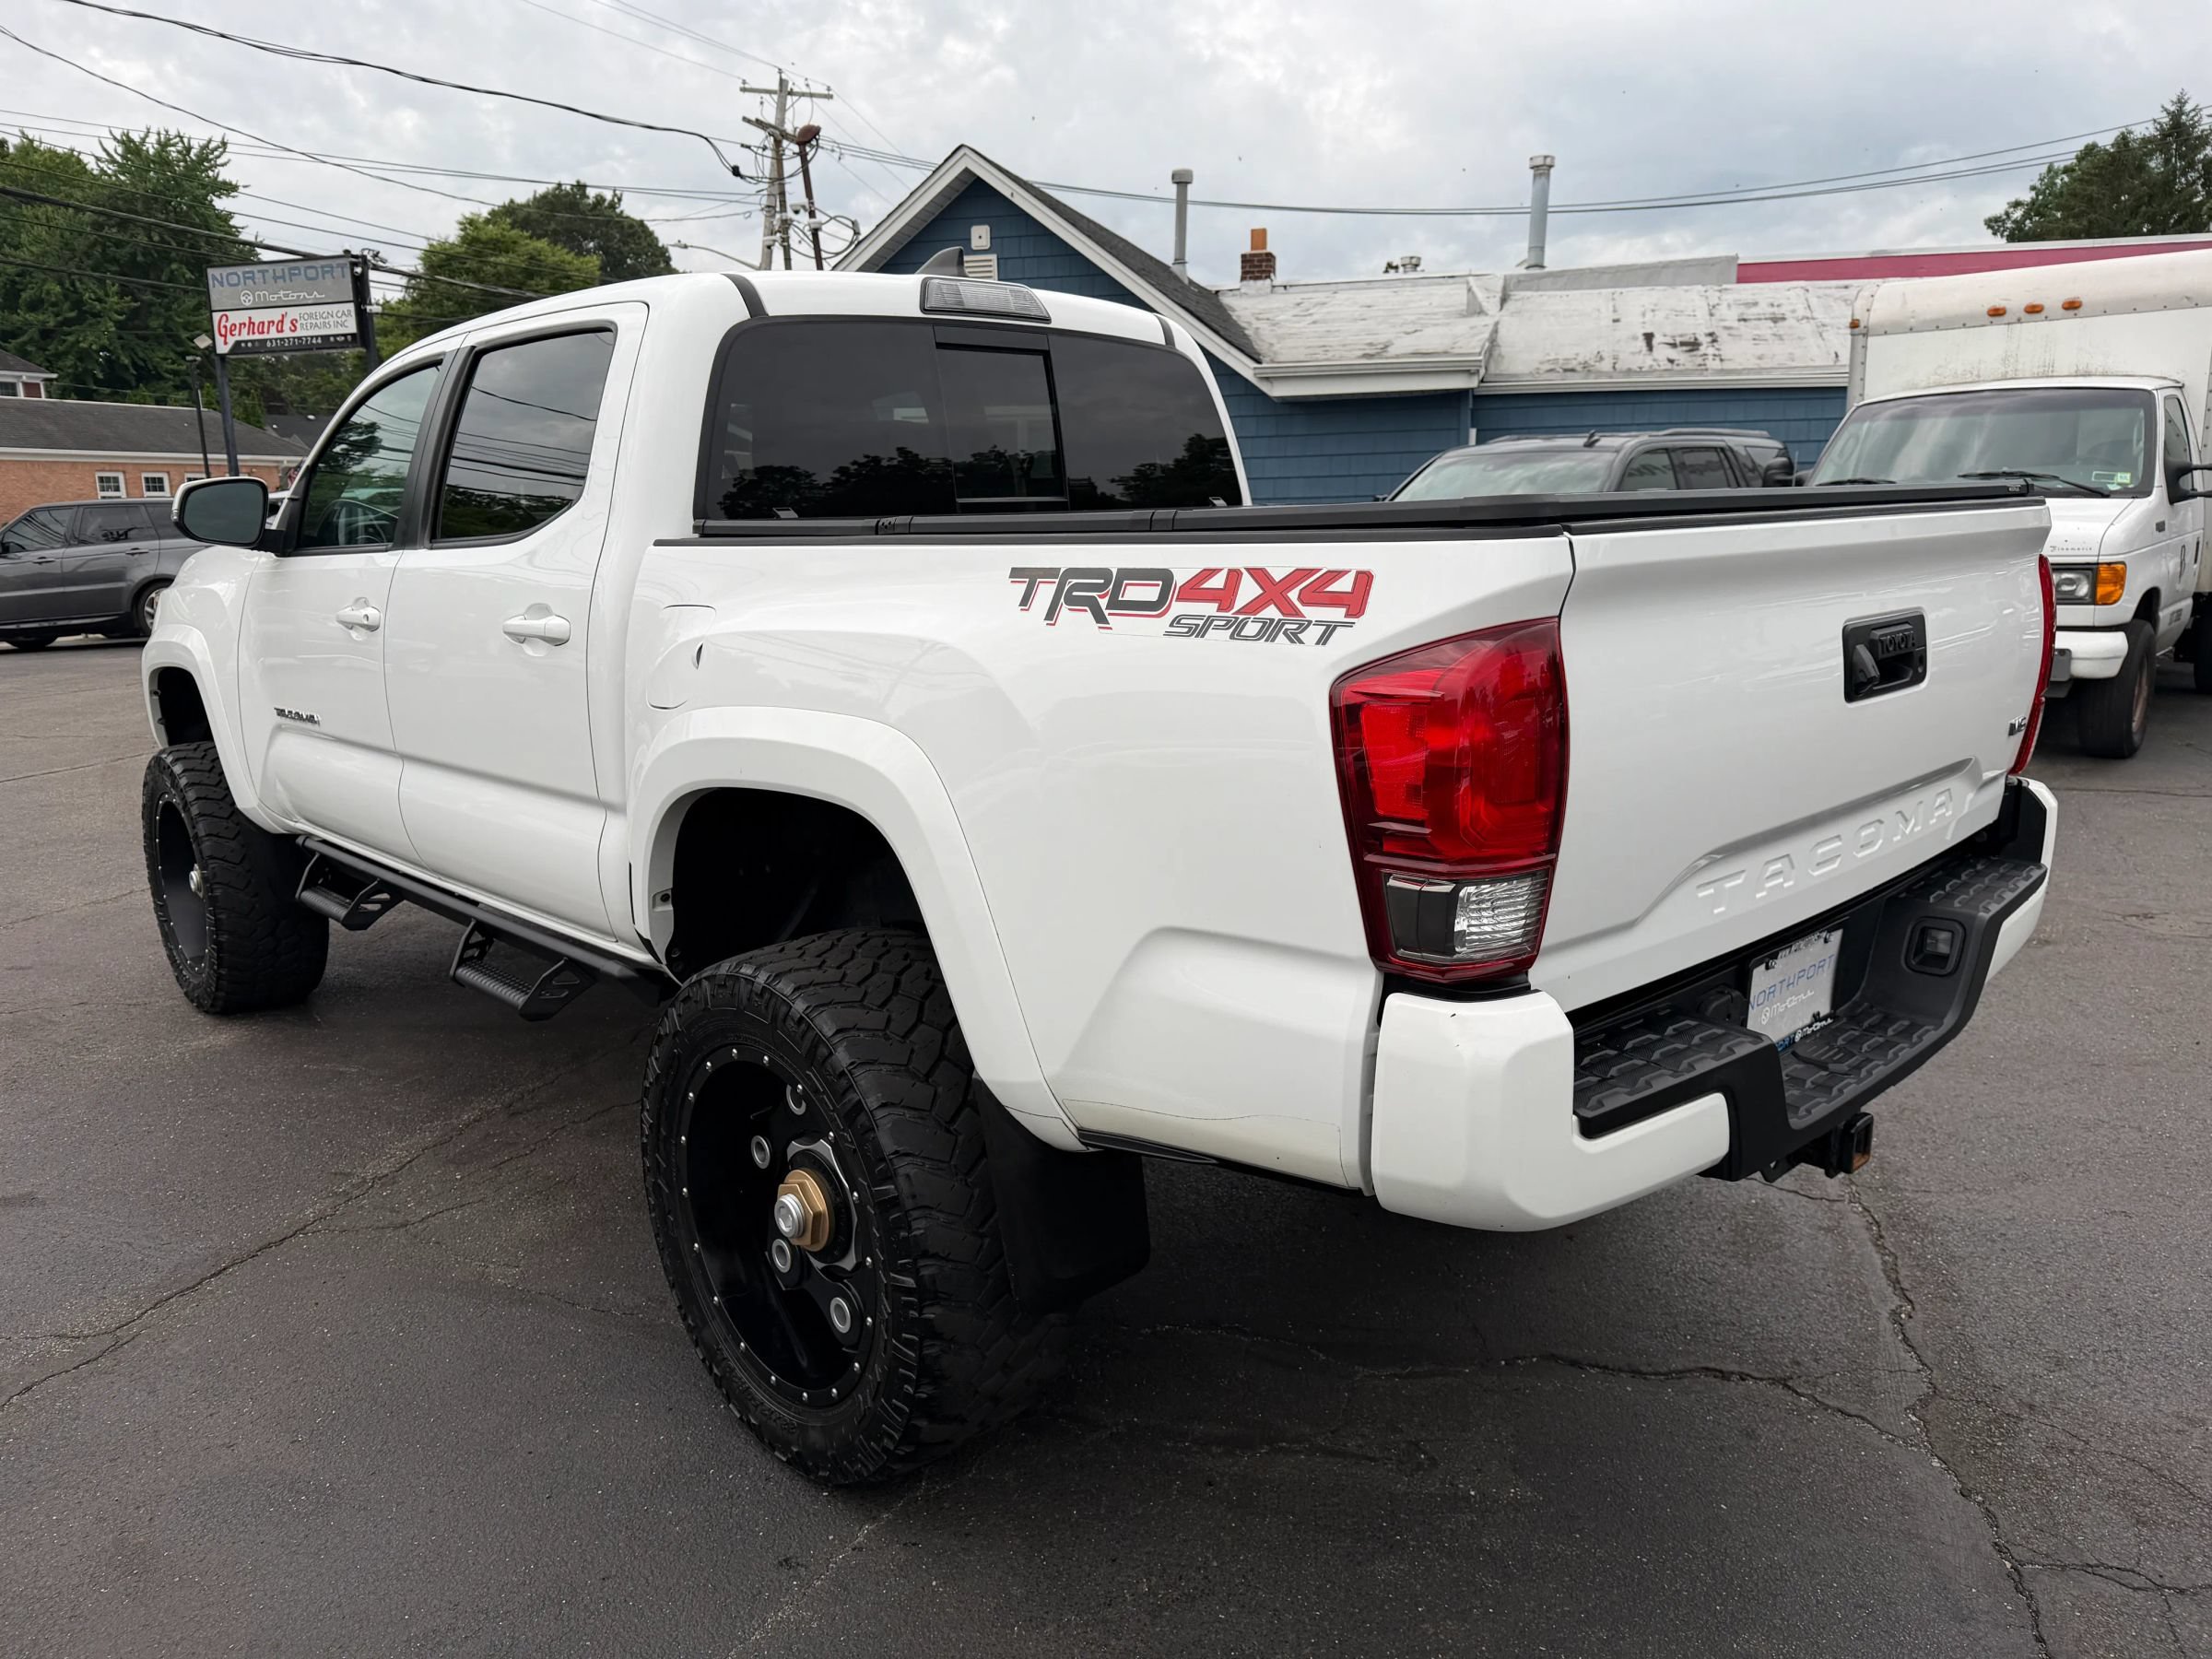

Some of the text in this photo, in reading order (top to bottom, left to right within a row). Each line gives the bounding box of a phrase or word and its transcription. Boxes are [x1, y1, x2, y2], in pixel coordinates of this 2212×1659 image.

[211, 263, 347, 288] NORTHPORT
[218, 312, 298, 346] Gerhard's
[299, 309, 352, 321] FOREIGN CAR
[300, 319, 349, 331] REPAIRS INC
[1008, 567, 1177, 630] TRD
[1162, 614, 1356, 646] SPORT
[1879, 630, 1916, 655] TOYOTA
[1695, 788, 1953, 914] TACOMA
